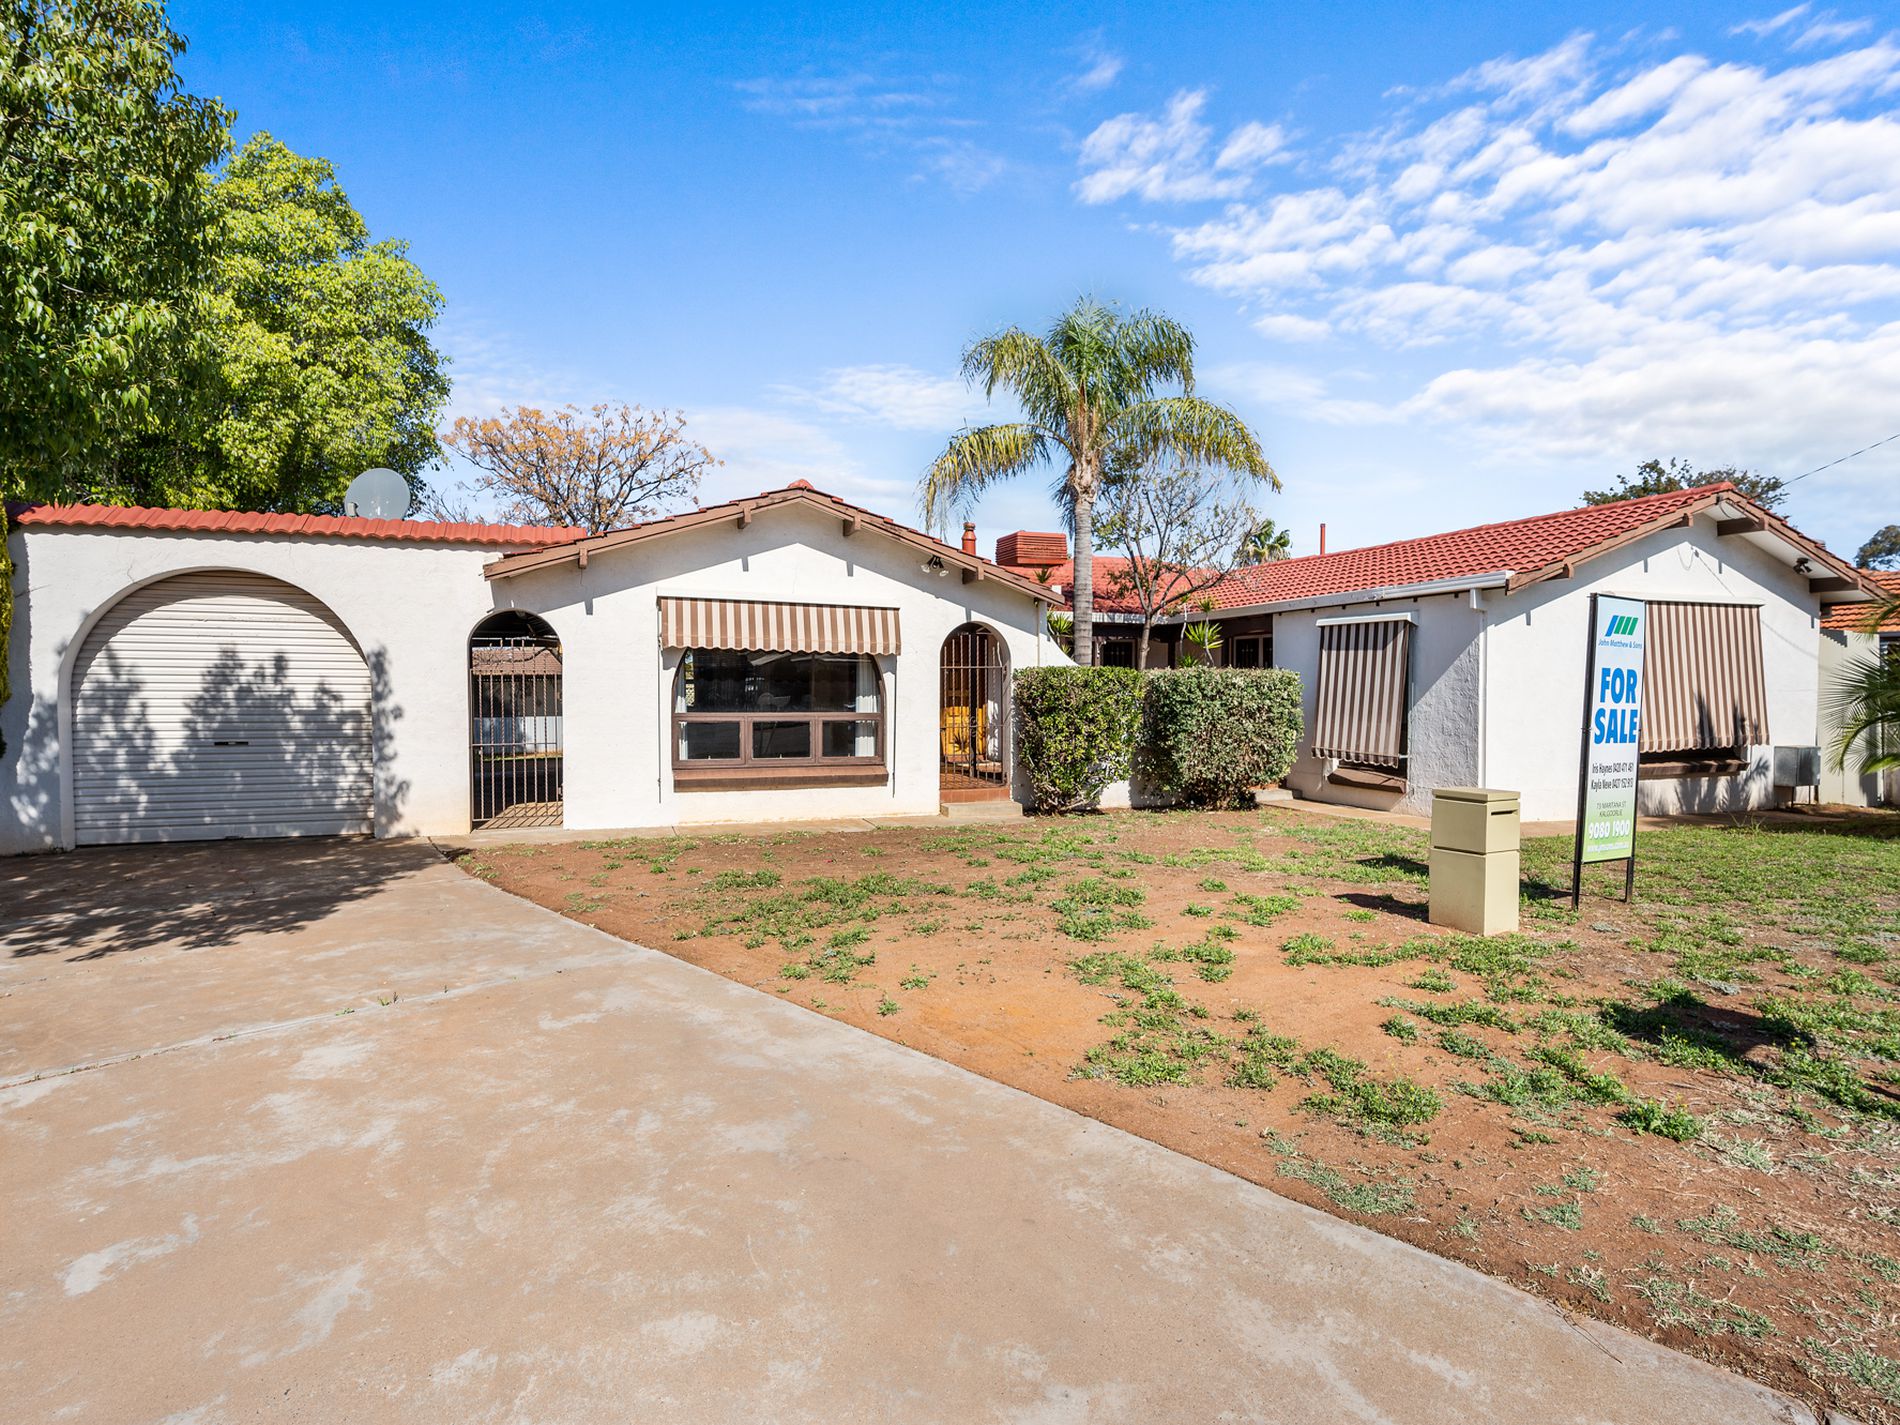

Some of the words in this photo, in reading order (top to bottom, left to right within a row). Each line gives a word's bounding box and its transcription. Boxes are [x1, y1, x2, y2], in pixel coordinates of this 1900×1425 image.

[1610, 640, 1628, 648] Matthew
[1633, 641, 1642, 649] Sons
[1600, 667, 1637, 704] FOR
[1594, 707, 1638, 744] SALE
[1591, 779, 1601, 792] Kayla
[1588, 821, 1610, 840] 9080
[1612, 819, 1630, 838] 1900
